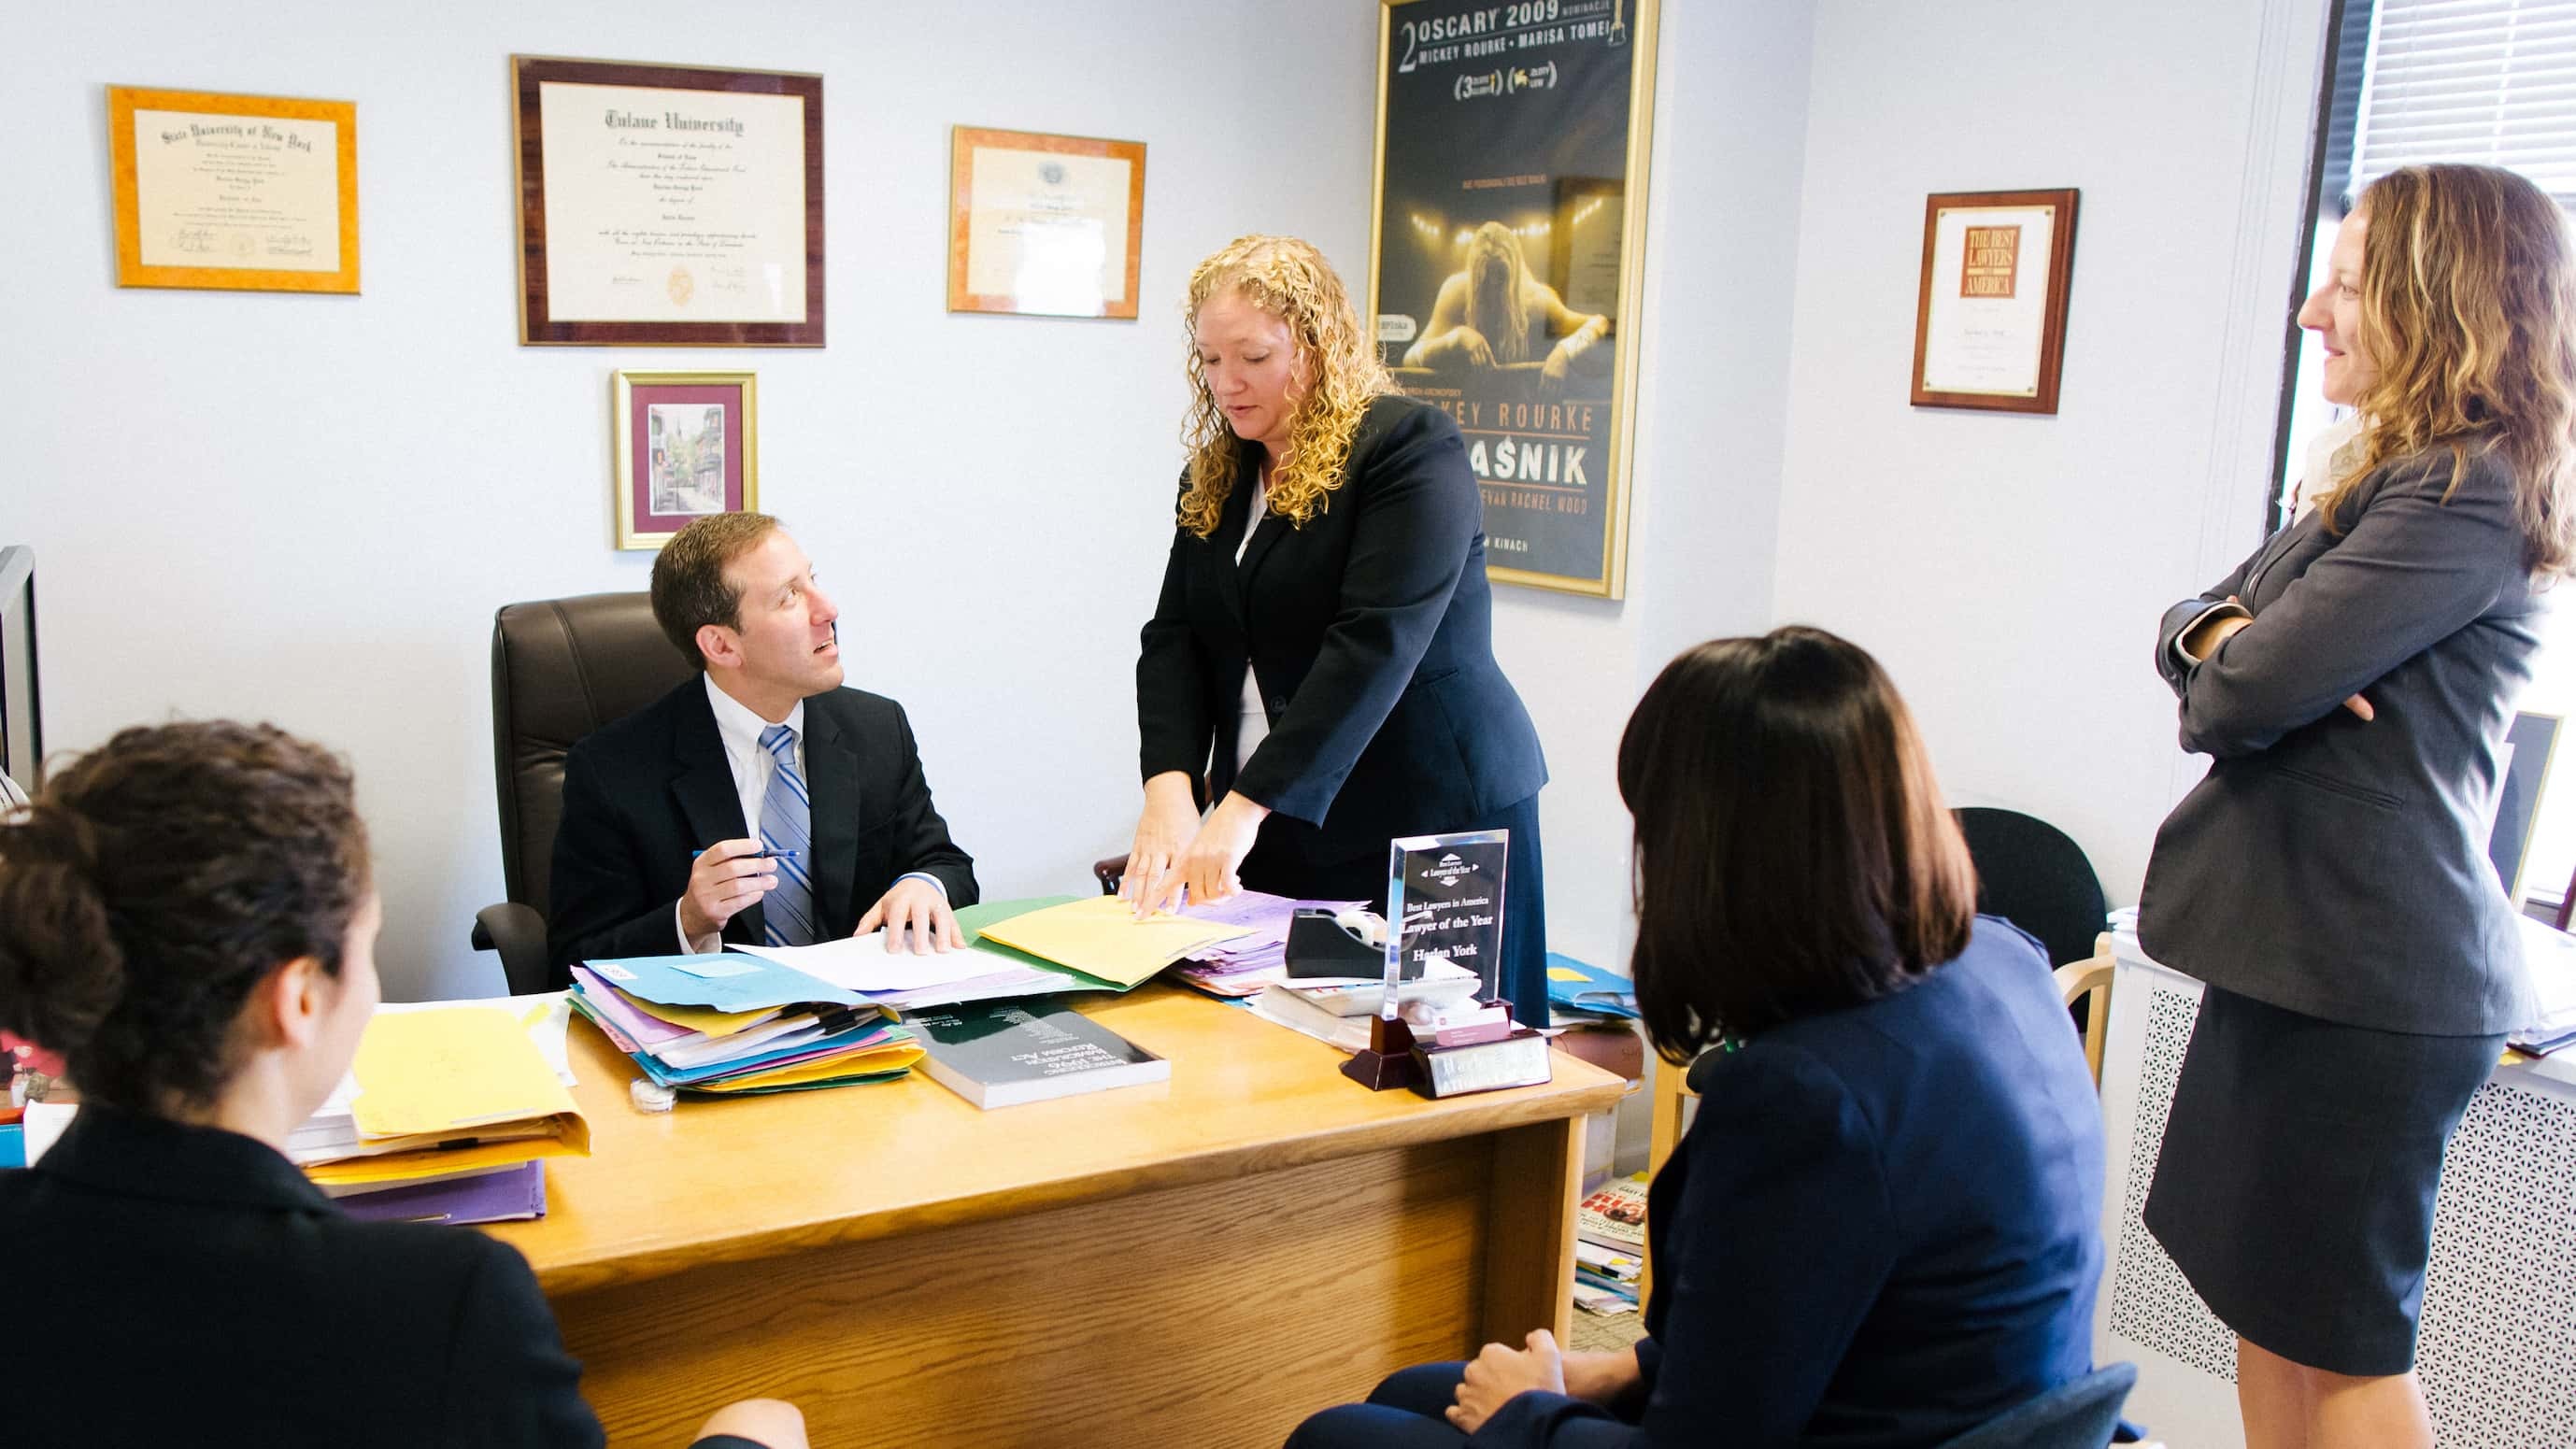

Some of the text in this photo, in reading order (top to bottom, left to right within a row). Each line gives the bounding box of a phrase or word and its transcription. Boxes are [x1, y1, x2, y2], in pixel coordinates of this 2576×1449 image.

[1399, 21, 1417, 73] 2
[1418, 9, 1497, 42] OSCARY
[1506, 0, 1558, 27] 2009
[1418, 20, 1610, 64] MICKEY ROURKE MARISA TOMEI
[605, 109, 745, 137] Tulane University
[161, 130, 188, 145] State
[190, 123, 244, 138] University
[246, 126, 257, 136] of
[262, 125, 283, 143] New
[287, 134, 312, 153] York
[1969, 230, 2016, 249] THE BEST
[1968, 249, 2013, 267] LAWYERS
[1965, 276, 2011, 294] AMERICA
[1499, 402, 1593, 432] ROURKE
[1470, 434, 1587, 485] AŚNIK
[1511, 490, 1551, 511] RACHEL
[1557, 495, 1587, 515] WOOD
[1407, 896, 1489, 912] Best Lawyers in America
[1401, 915, 1493, 935] Lawyer of the Year
[1452, 943, 1478, 958] York
